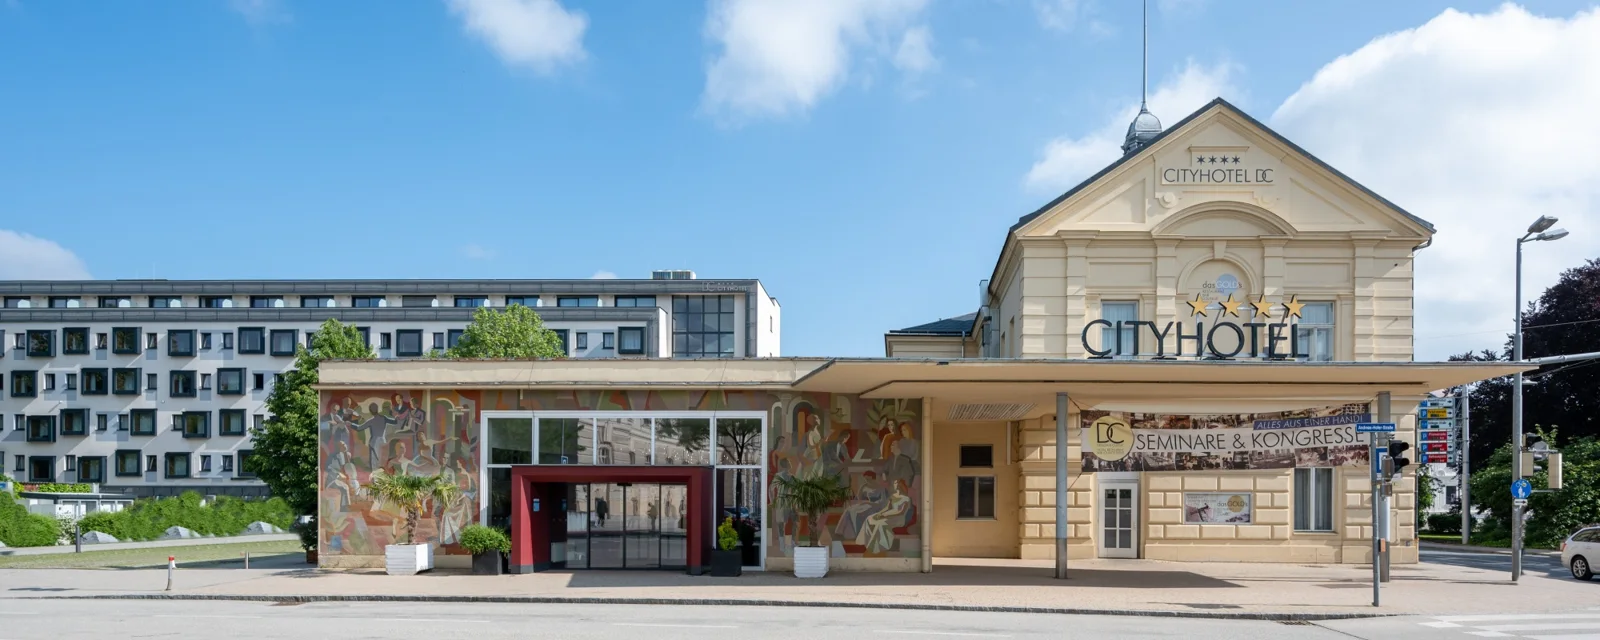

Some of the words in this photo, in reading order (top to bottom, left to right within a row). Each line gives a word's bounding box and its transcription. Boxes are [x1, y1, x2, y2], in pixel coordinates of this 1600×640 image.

[1163, 168, 1251, 183] CITYHOTEL
[1081, 318, 1310, 359] CITYHOTEL
[1096, 422, 1125, 444] DC
[1257, 421, 1281, 430] ALLES
[1283, 419, 1302, 429] AUS
[1304, 417, 1330, 427] EINER
[1136, 433, 1227, 450] SEMINARE
[1232, 433, 1246, 449] &
[1251, 426, 1365, 449] KONGRESSE
